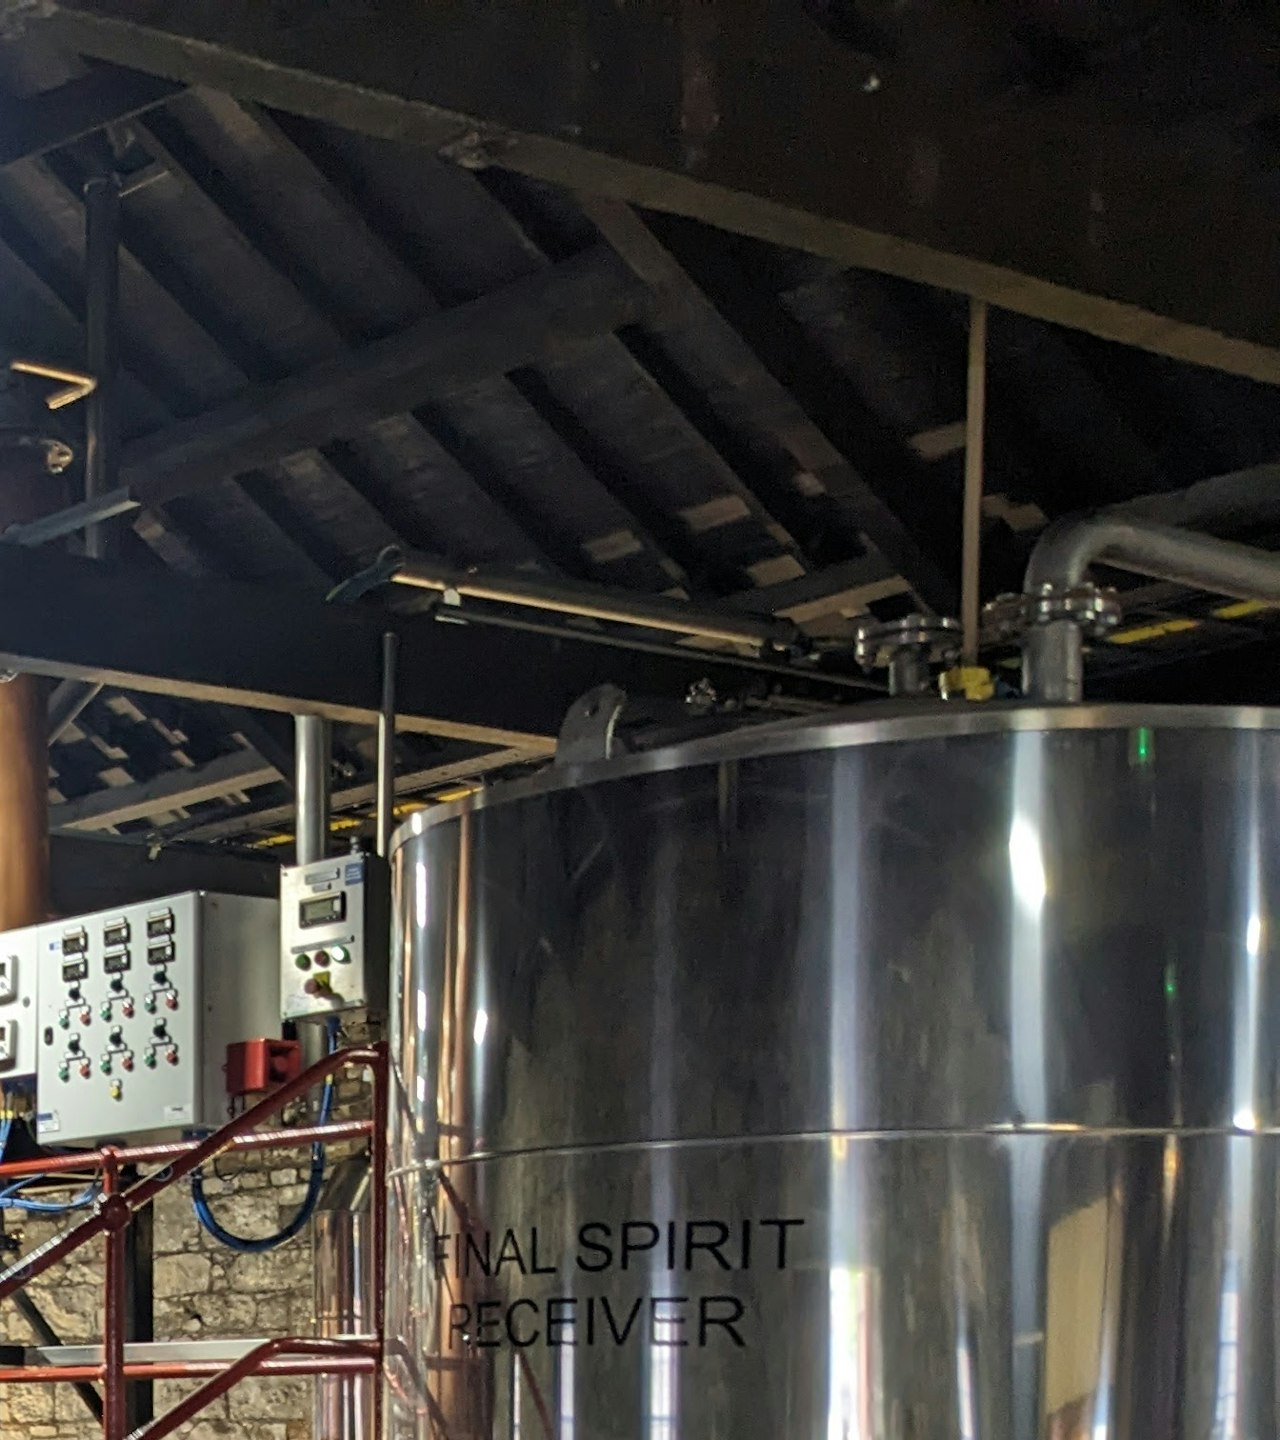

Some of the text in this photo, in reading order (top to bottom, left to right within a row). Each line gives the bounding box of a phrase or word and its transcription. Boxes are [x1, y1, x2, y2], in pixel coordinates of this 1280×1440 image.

[434, 1218, 805, 1280] FINAL SPIRIT
[448, 1295, 747, 1350] RECEIVER
